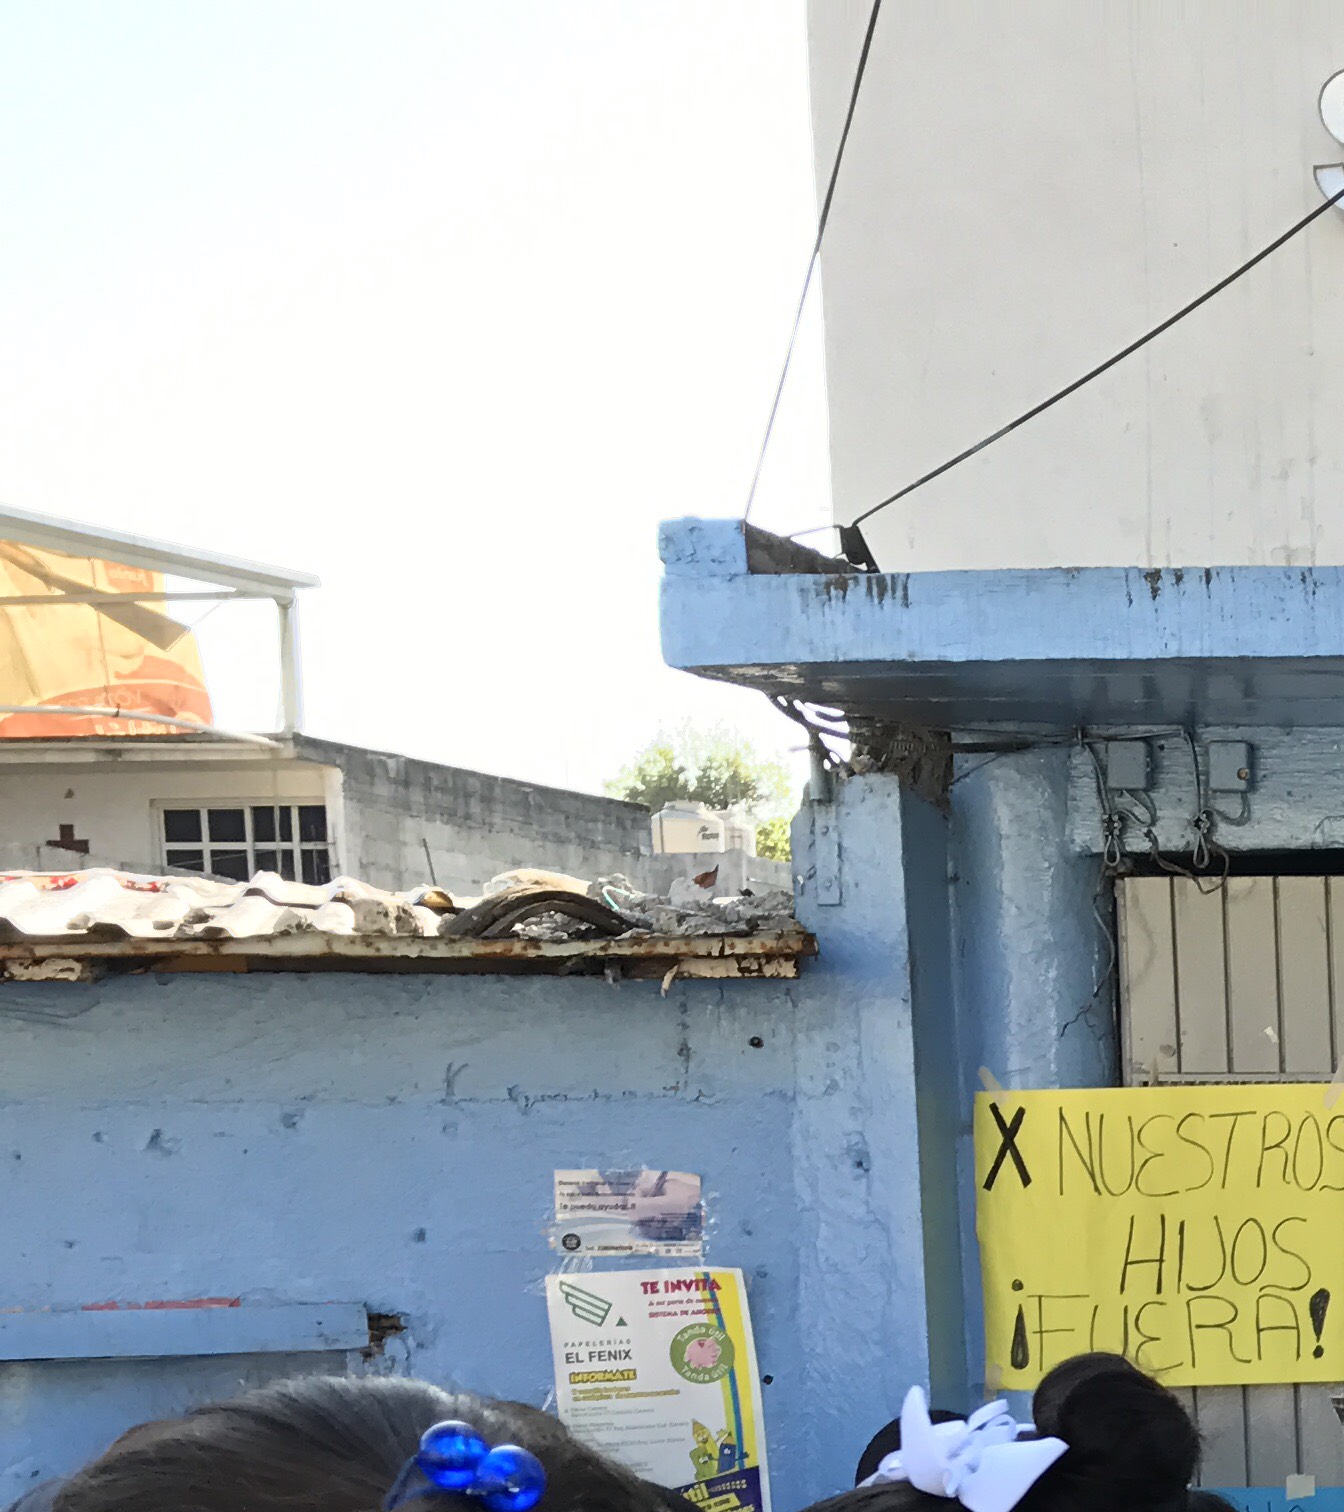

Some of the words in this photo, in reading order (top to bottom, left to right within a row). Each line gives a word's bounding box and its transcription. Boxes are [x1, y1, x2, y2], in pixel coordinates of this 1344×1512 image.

[1119, 1214, 1312, 1295] HIJOS
[641, 1280, 660, 1295] TE
[664, 1278, 722, 1294] INVITA
[1008, 1279, 1332, 1371] ¡FUERA!
[565, 1352, 586, 1364] EL
